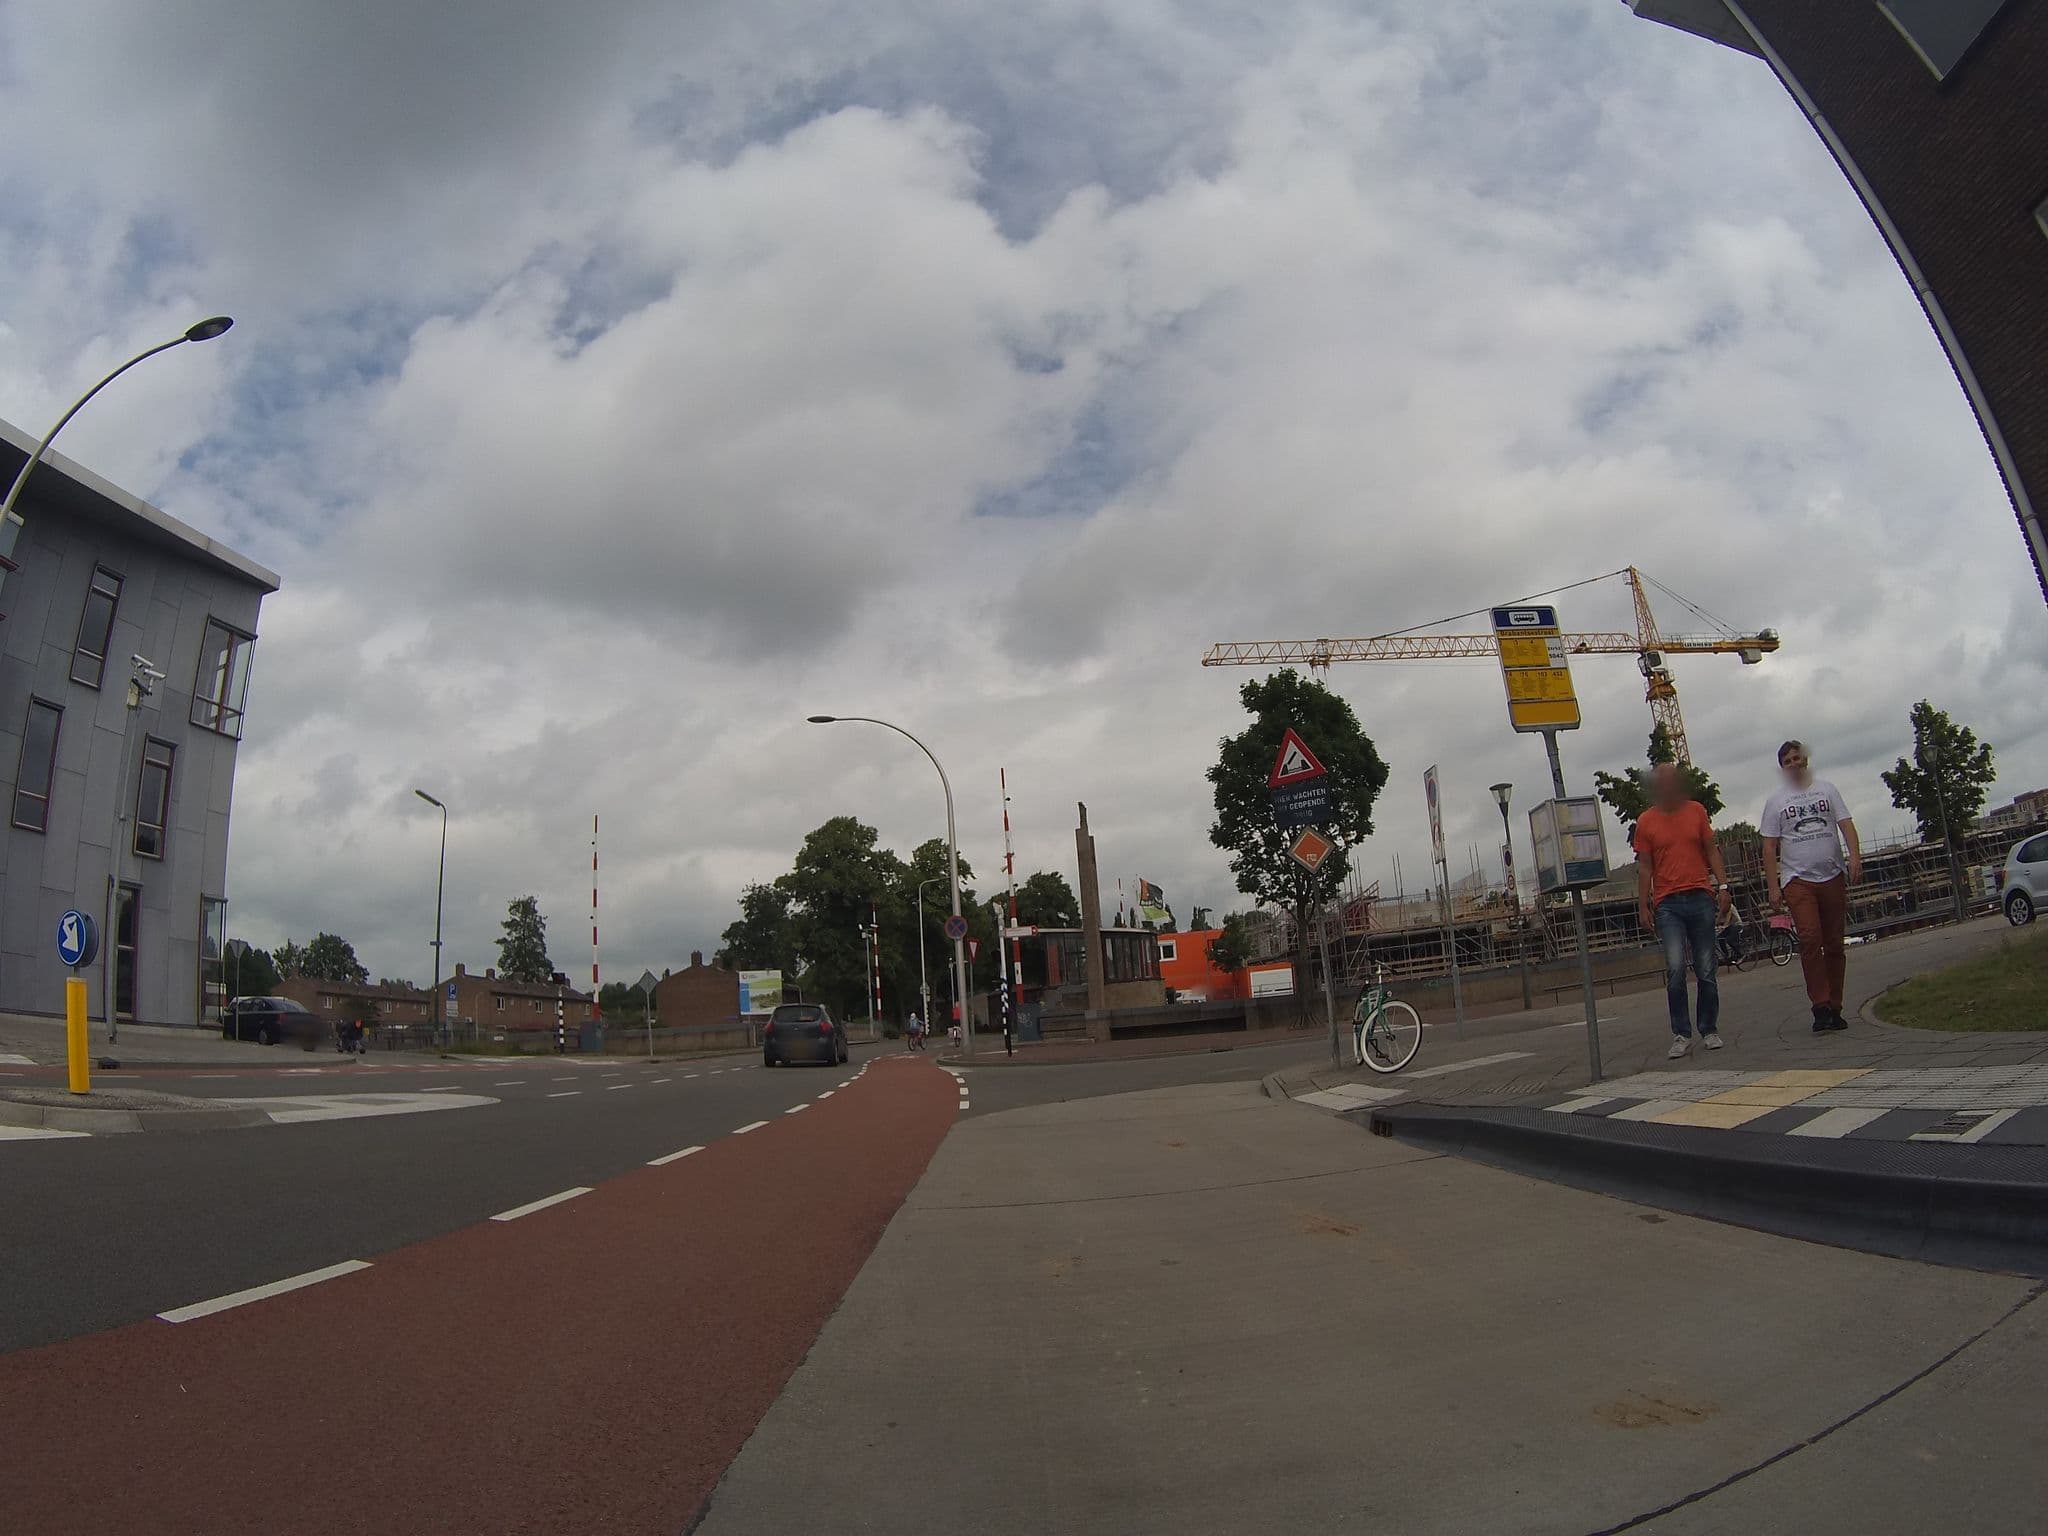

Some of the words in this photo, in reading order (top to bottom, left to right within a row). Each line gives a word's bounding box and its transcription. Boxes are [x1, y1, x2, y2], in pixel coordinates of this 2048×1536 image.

[1293, 788, 1326, 801] WACHTEN
[1290, 798, 1326, 810] GEOPENDE
[1783, 806, 1797, 820] 19
[1818, 800, 1830, 812] 81
